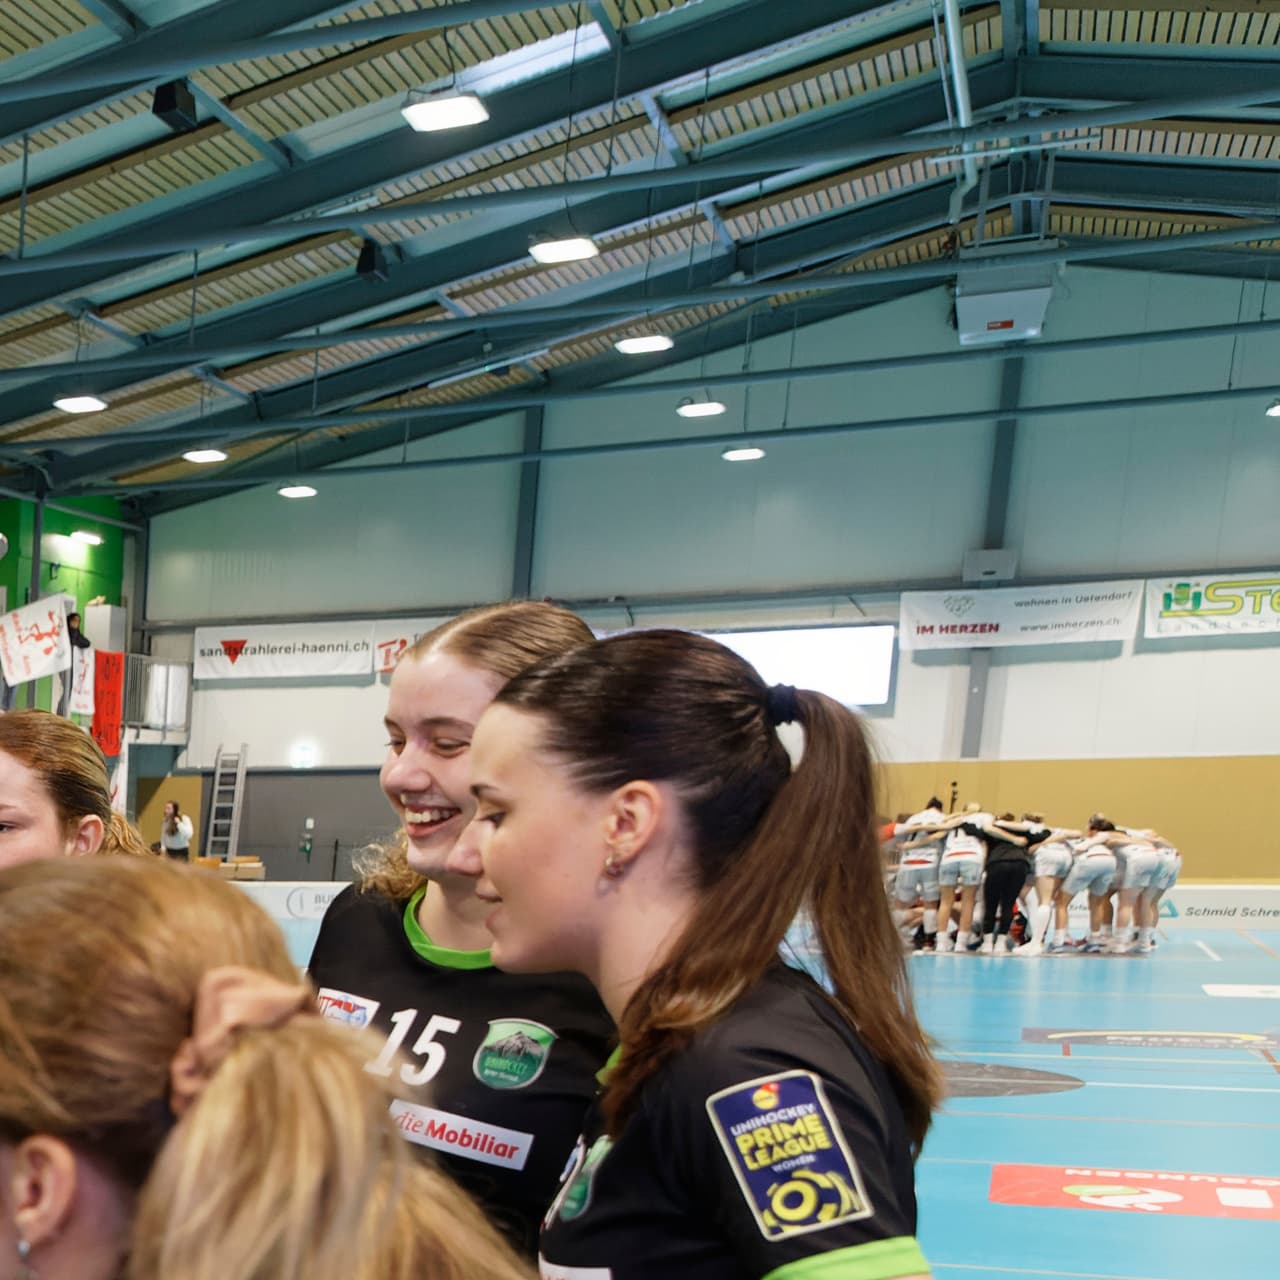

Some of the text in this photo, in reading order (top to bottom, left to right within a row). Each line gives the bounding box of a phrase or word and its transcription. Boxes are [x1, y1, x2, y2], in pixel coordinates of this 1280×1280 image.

[940, 624, 999, 634] HERZEN
[1185, 906, 1237, 917] Schmid
[363, 1008, 461, 1086] 15
[731, 1103, 815, 1136] UNIHOCKEY
[736, 1114, 825, 1154] PRIME
[425, 1119, 519, 1161] Mobiliar
[744, 1132, 832, 1172] LEAGUE
[771, 1154, 816, 1173] WOMEN
